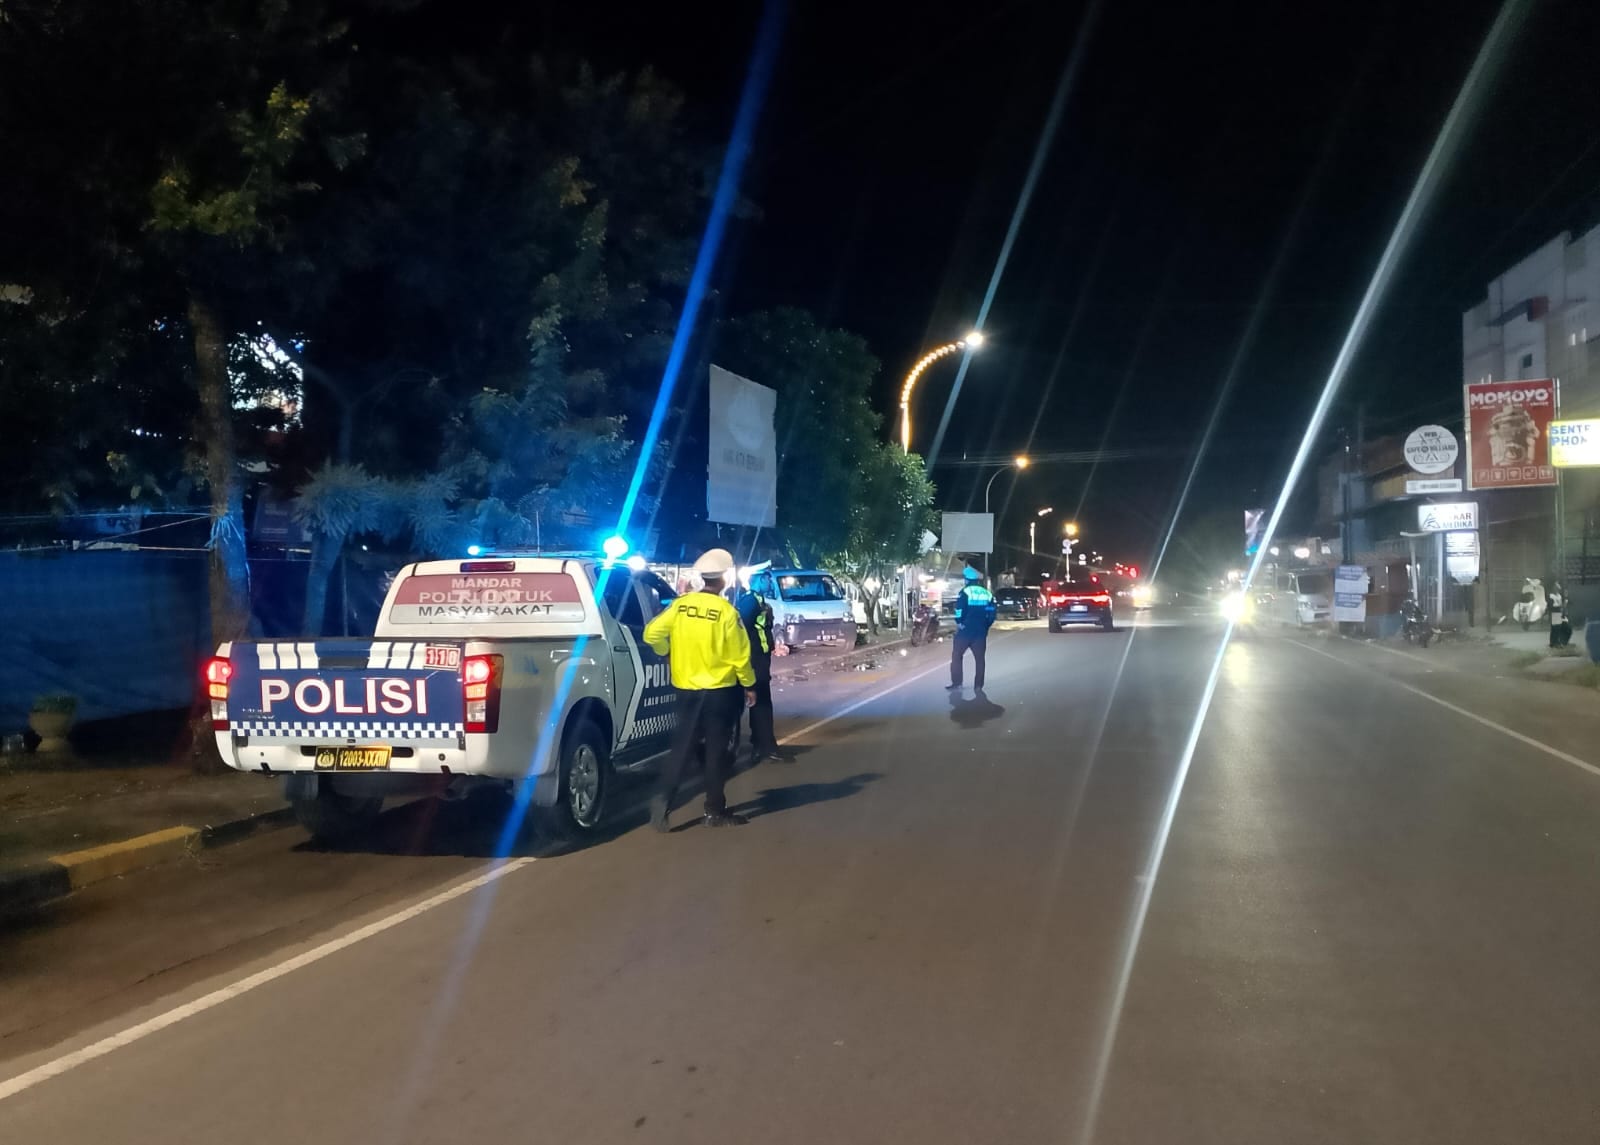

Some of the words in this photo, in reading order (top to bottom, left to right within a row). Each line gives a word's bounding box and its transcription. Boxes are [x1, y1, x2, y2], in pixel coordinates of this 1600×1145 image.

[1470, 388, 1549, 406] MOMOYO
[451, 577, 522, 588] MANDAR
[418, 604, 554, 617] MASYARAKAT
[677, 605, 722, 622] POLISI
[427, 648, 459, 667] 110
[260, 677, 428, 715] POLISI
[643, 696, 659, 708] LALU
